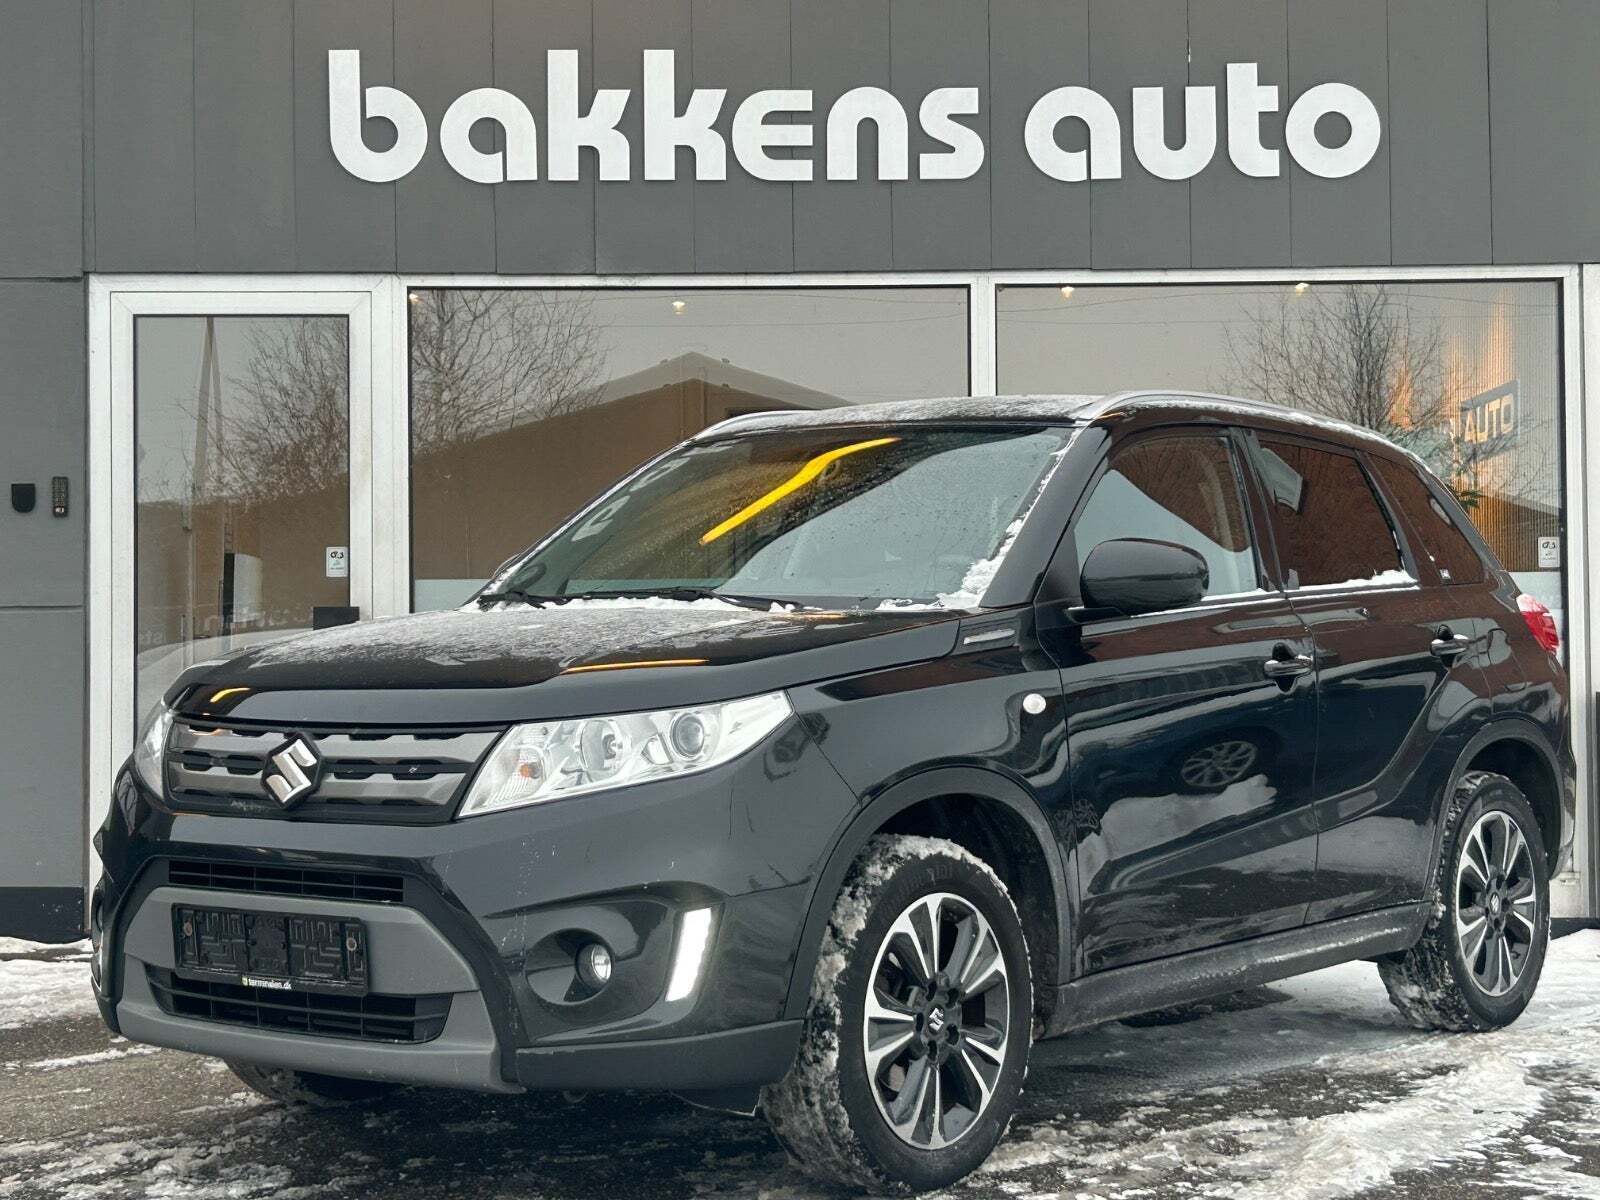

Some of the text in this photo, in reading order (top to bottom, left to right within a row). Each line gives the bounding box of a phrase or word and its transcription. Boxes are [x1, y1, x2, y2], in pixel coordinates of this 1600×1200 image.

[328, 48, 1382, 184] bakkens auto
[1464, 393, 1514, 445] AUTO
